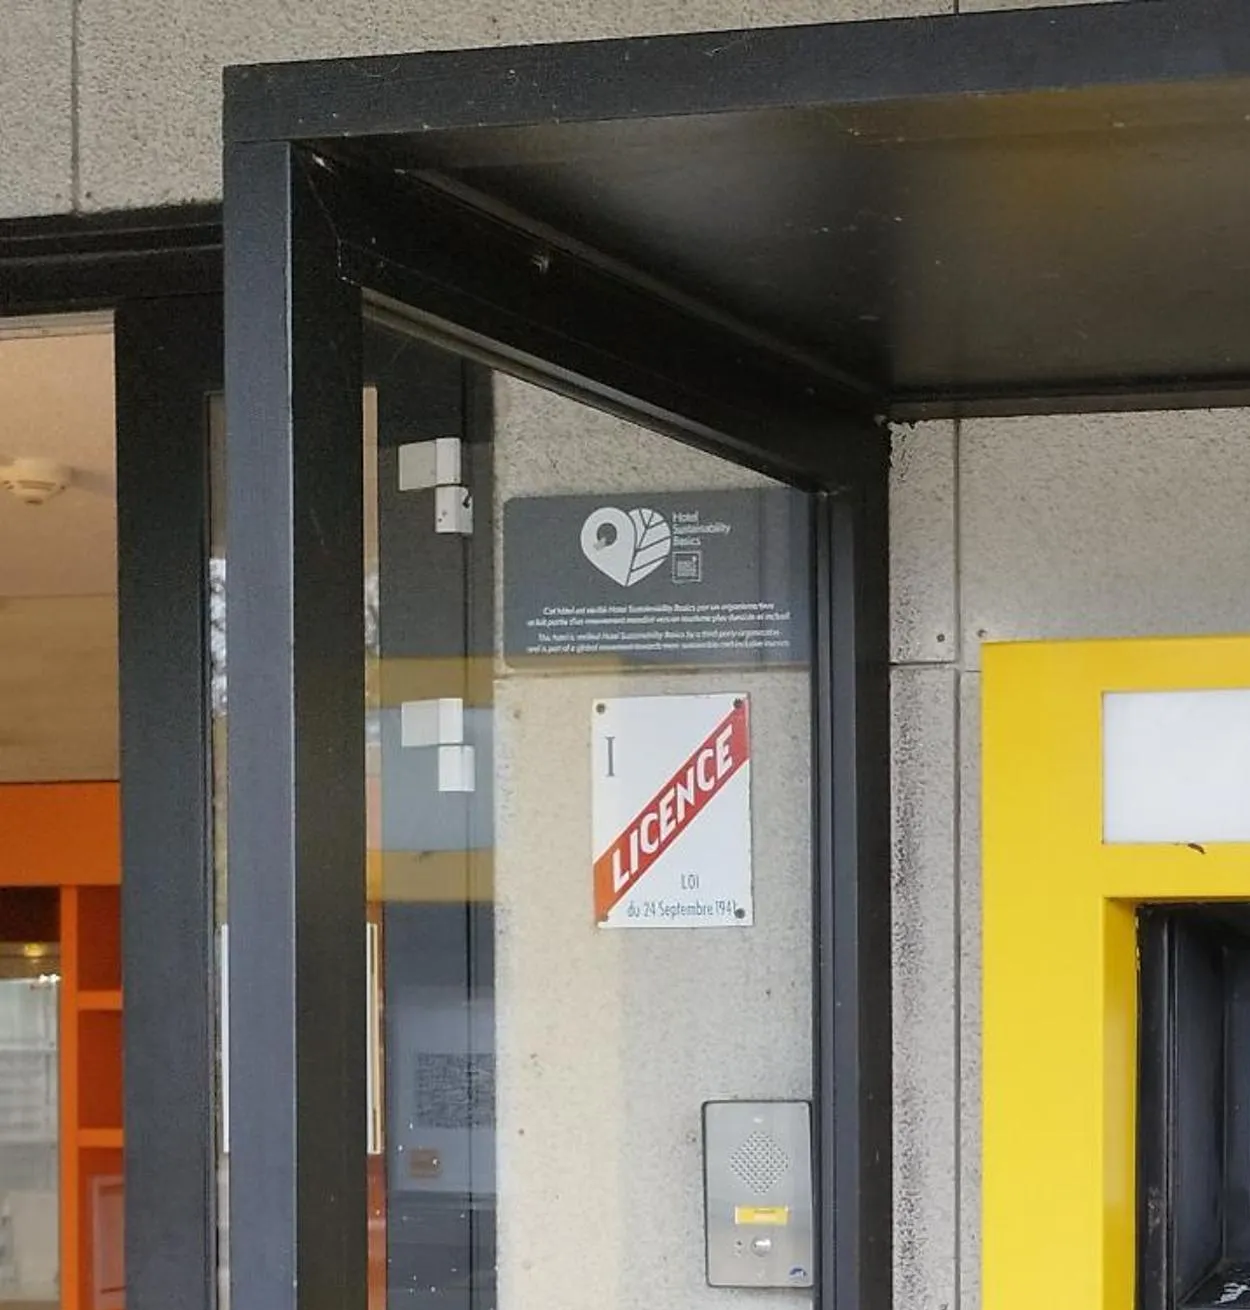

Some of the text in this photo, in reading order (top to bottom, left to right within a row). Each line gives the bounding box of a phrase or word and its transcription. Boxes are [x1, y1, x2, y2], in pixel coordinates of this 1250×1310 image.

[672, 510, 699, 522] Hotel
[612, 723, 733, 893] LICENCE
[681, 874, 700, 890] LOI
[628, 901, 640, 917] du
[657, 900, 713, 920] Septembre
